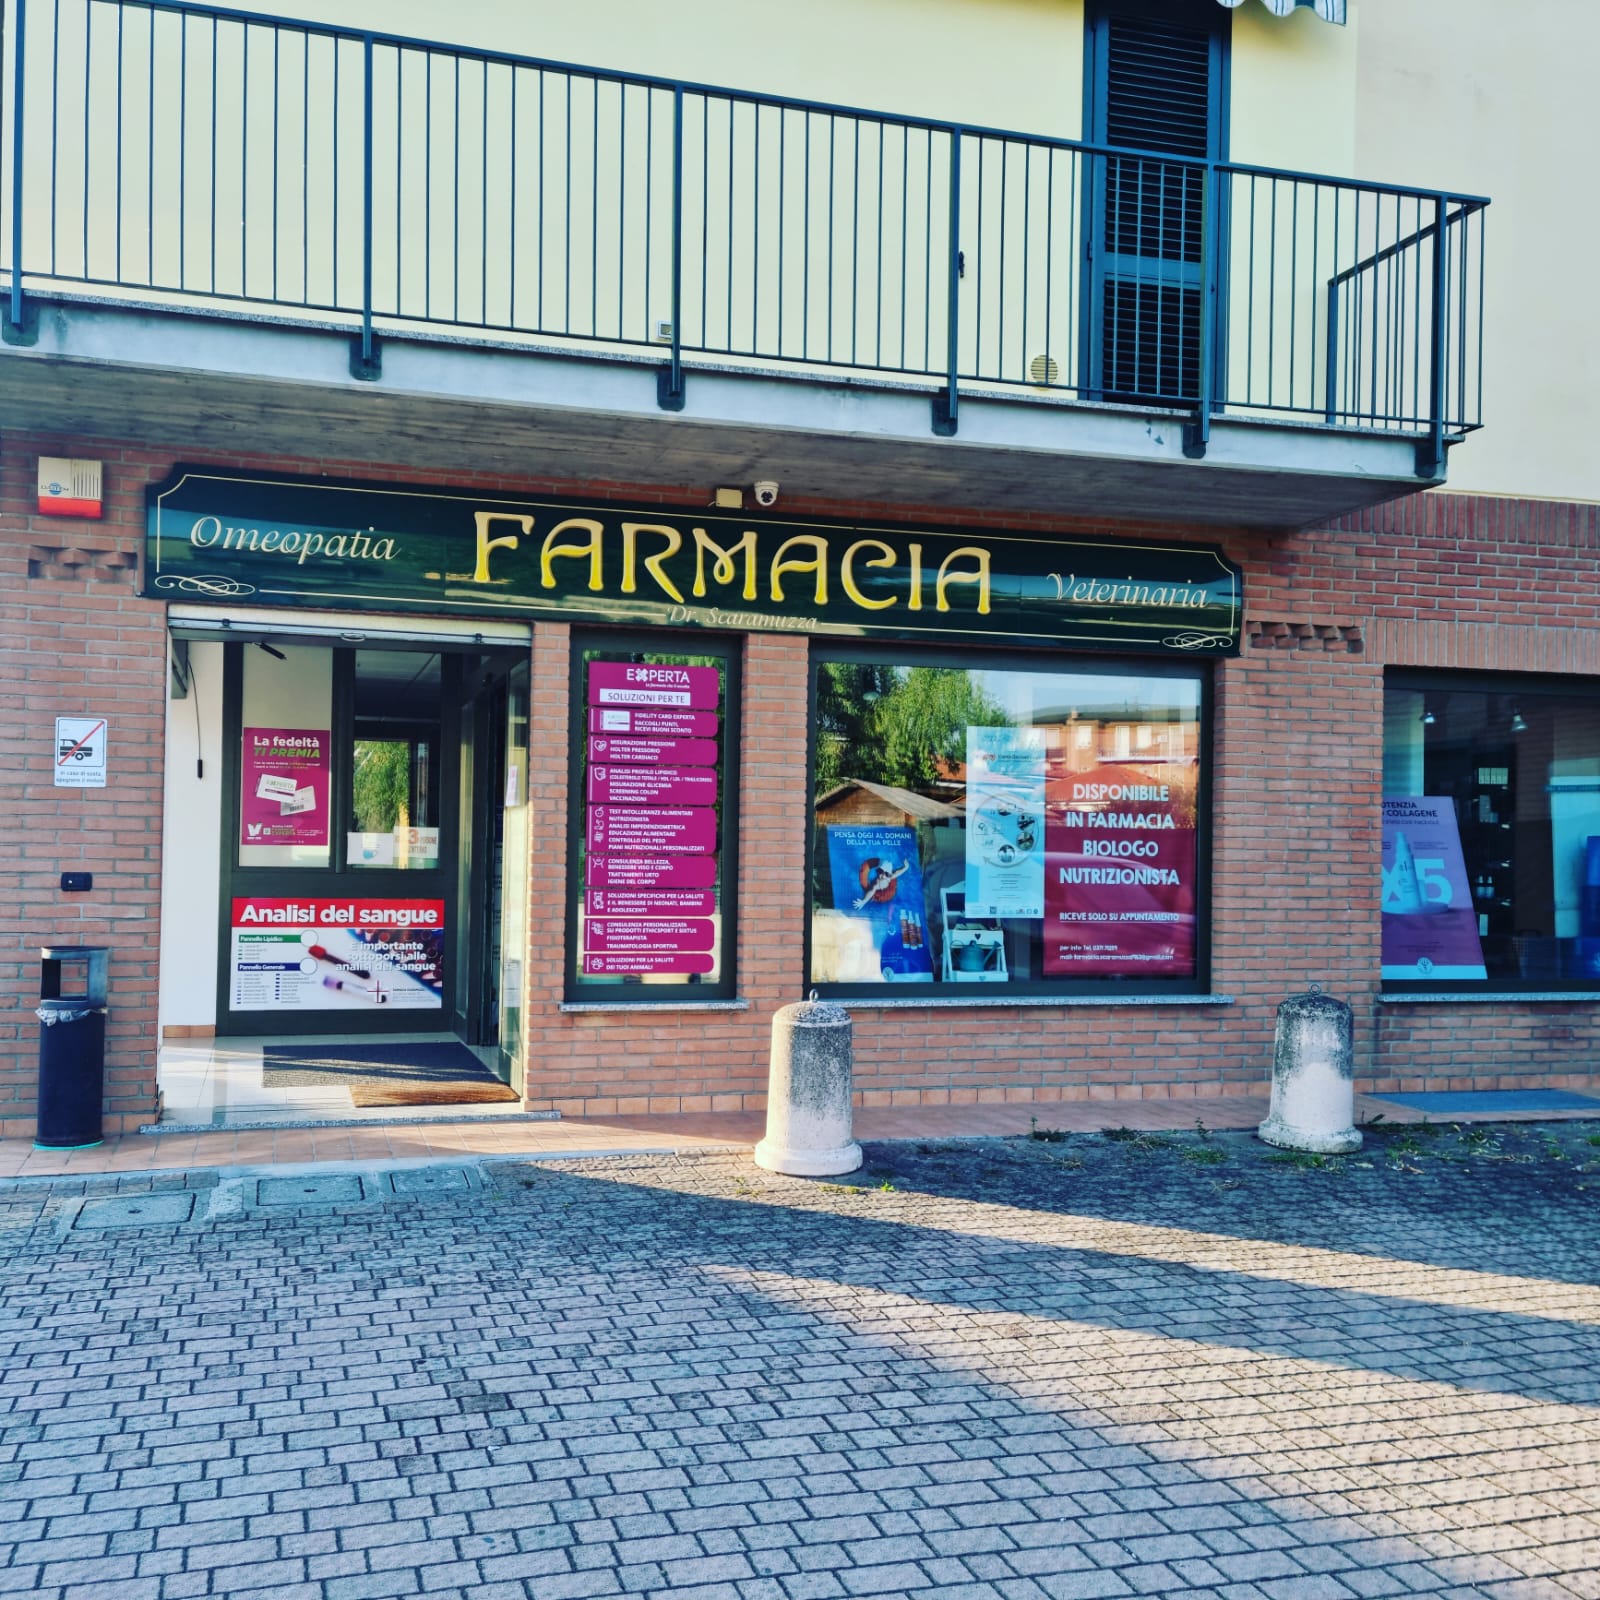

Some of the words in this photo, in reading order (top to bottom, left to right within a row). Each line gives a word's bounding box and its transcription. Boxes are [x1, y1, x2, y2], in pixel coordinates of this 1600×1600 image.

[190, 516, 401, 564] Omeopatia
[474, 511, 990, 614] FARMACIA
[1047, 573, 1210, 608] Veterinaria
[666, 606, 698, 624] Dr.
[705, 608, 817, 630] Scaramuzza
[627, 668, 690, 683] EXPERTA
[608, 693, 655, 702] SOLUZIONI
[658, 693, 674, 703] PER
[675, 695, 684, 703] TE
[254, 736, 270, 746] La
[273, 736, 320, 747] fedeltà
[254, 747, 266, 756] TI
[270, 748, 320, 758] PREMIA
[1073, 784, 1169, 801] DISPONIBILE
[1066, 812, 1083, 828] IN
[1088, 812, 1175, 829] FARMACIA
[1083, 840, 1158, 856] BIOLOGO
[1060, 868, 1180, 885] NUTRIZIONISTA
[240, 905, 316, 923] Analisi
[320, 905, 354, 923] del
[359, 909, 438, 926] sangue
[360, 941, 424, 953] importante
[348, 951, 403, 962] sottoporsi
[404, 951, 426, 960] alle
[336, 962, 372, 971] analisi
[376, 962, 393, 971] del
[395, 964, 436, 972] sangue
